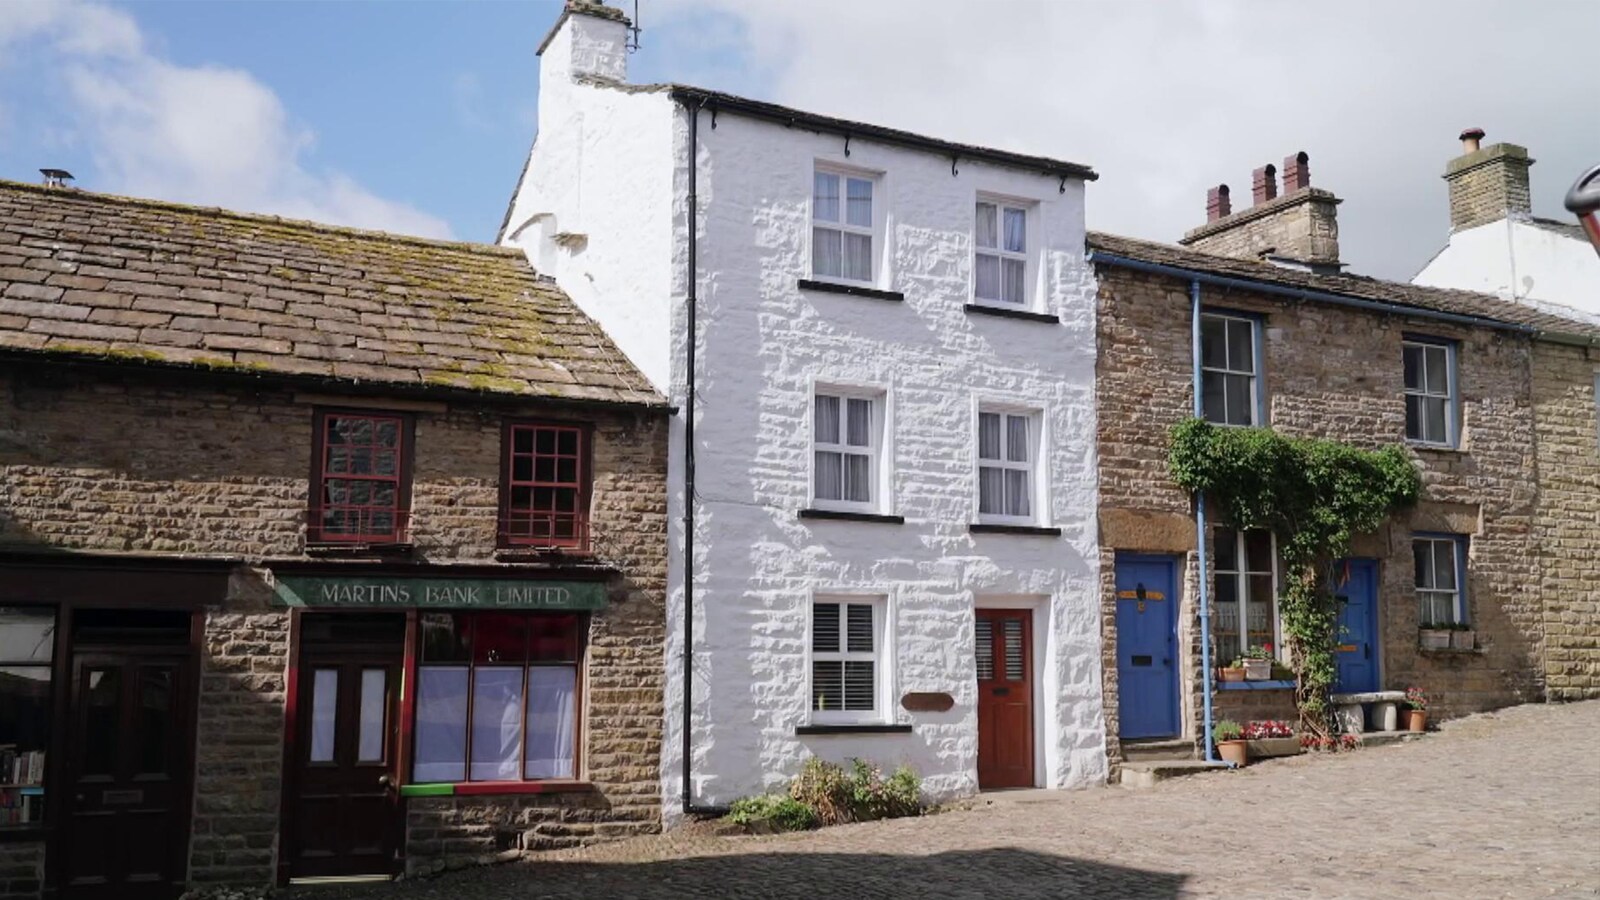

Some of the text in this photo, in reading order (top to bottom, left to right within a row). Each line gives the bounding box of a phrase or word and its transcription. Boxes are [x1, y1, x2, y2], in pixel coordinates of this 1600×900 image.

[321, 583, 571, 605] MARTINS BANK LIMITED
